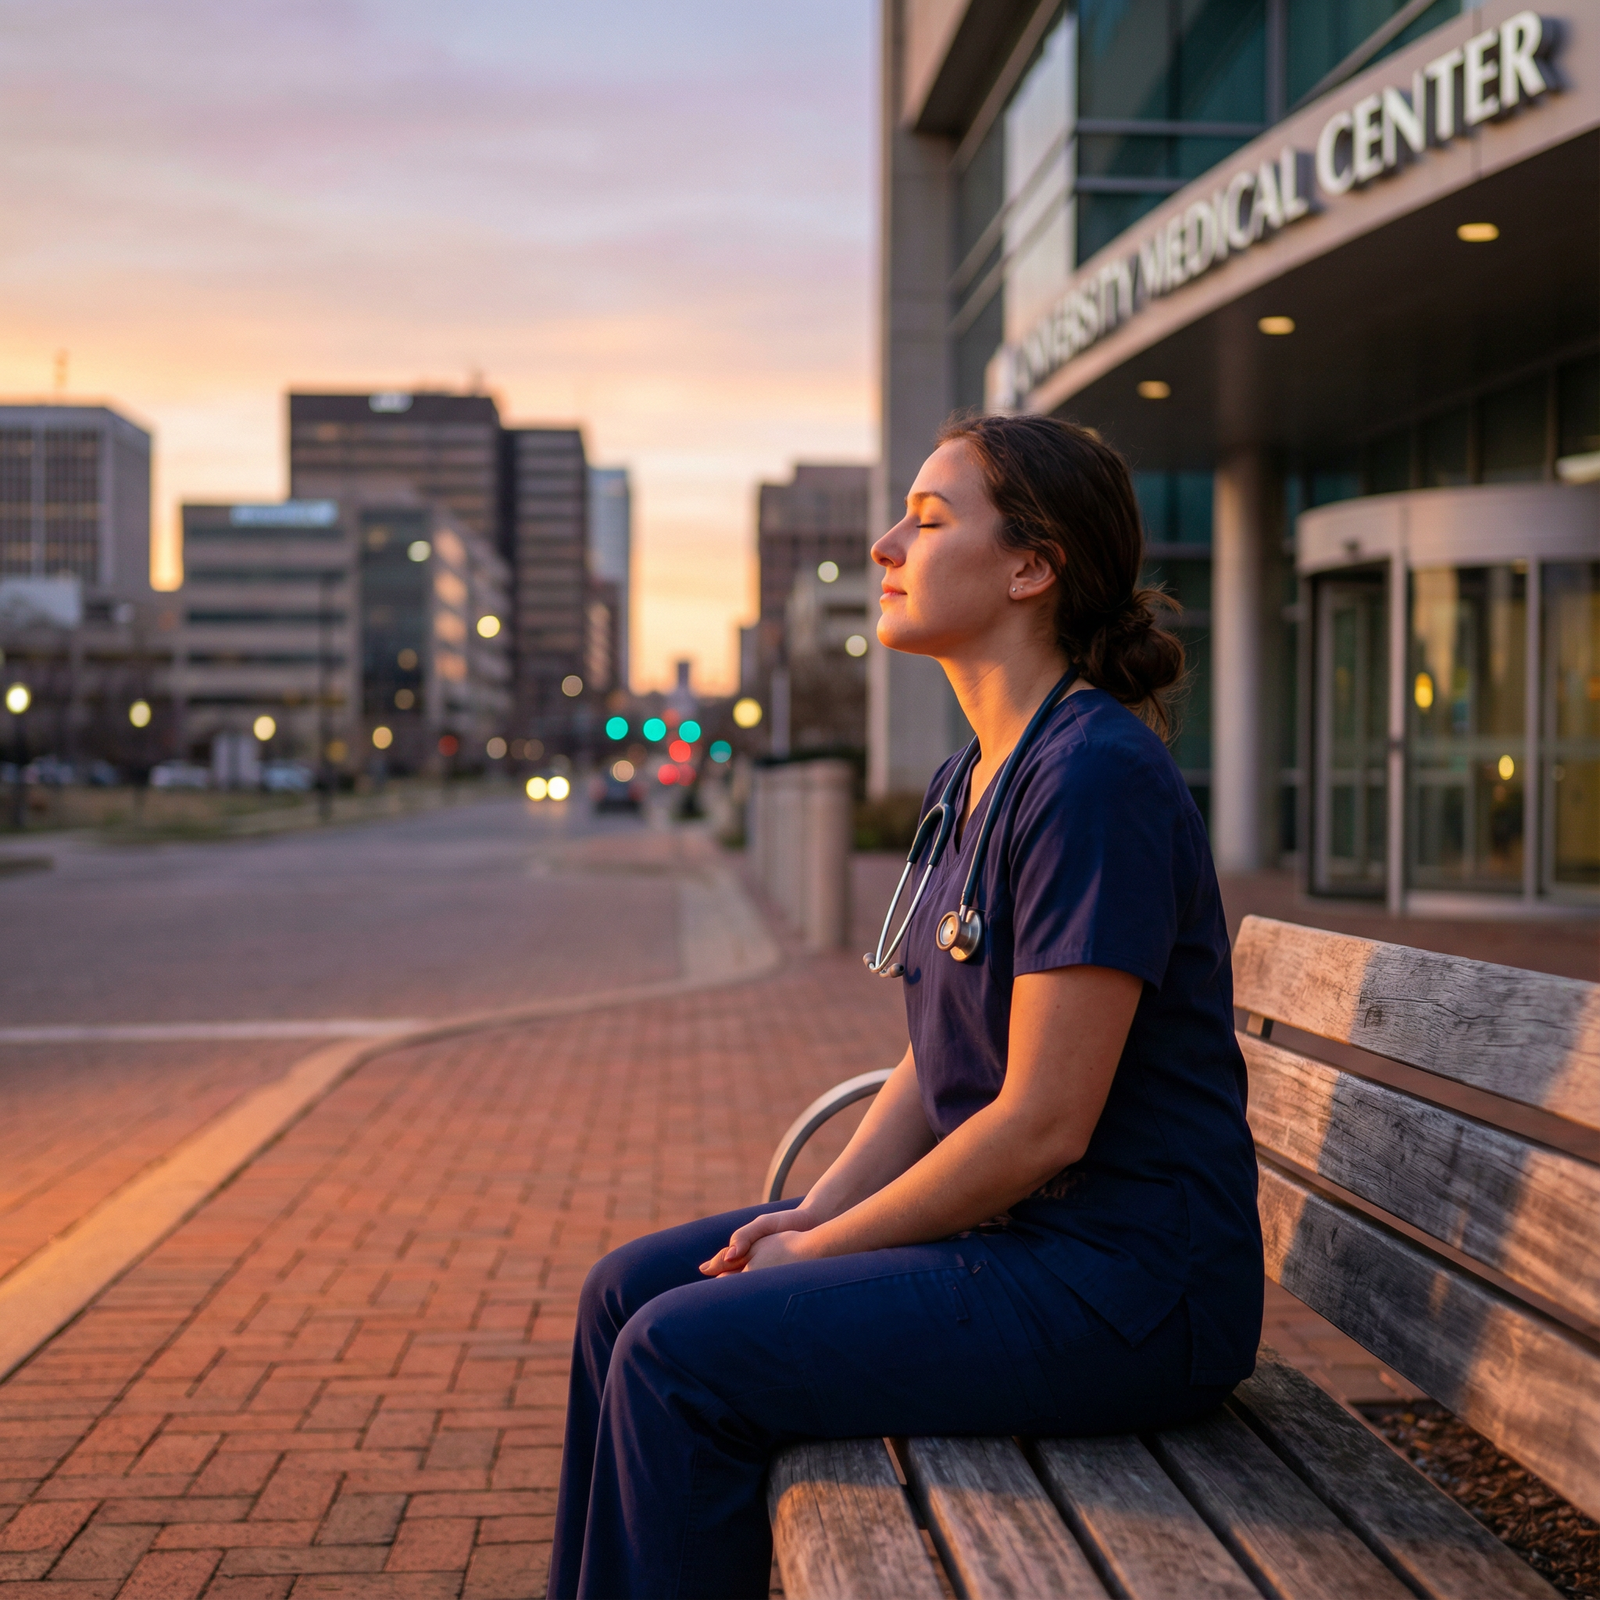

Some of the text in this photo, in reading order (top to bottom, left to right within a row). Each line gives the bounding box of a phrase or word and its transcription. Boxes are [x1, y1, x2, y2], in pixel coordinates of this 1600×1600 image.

[994, 10, 1547, 404] VERSITY MEDICAL CENTER
